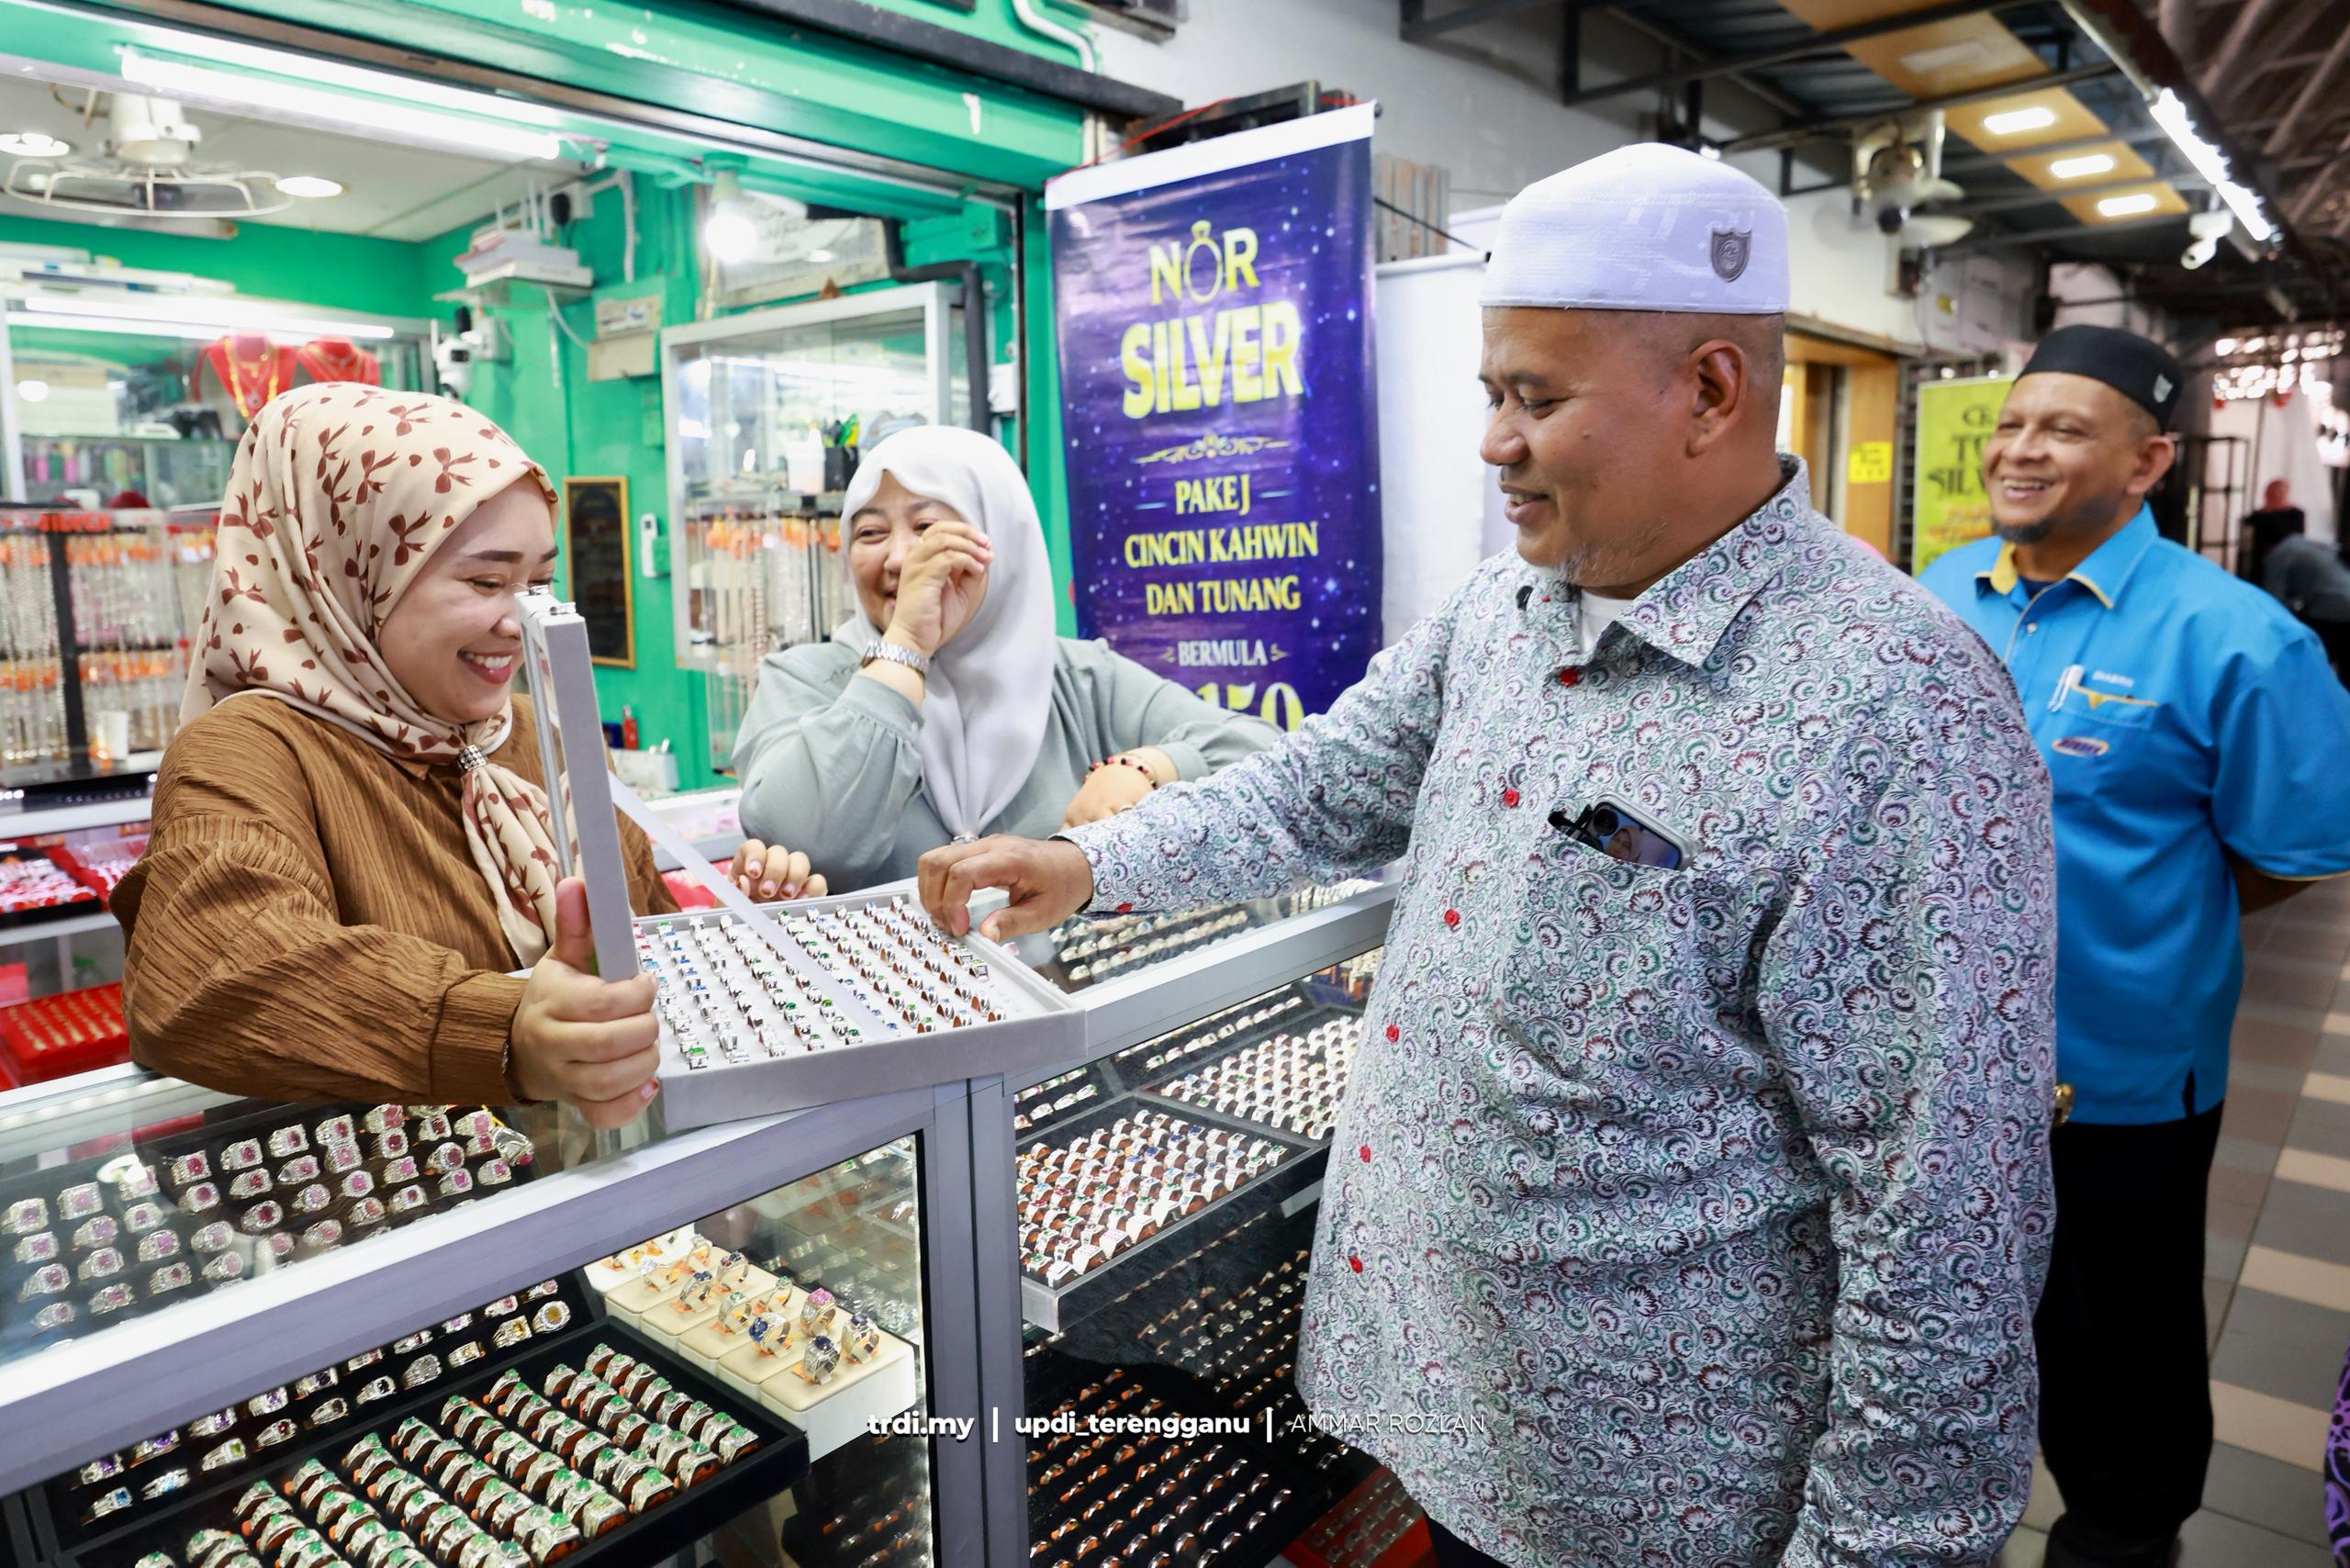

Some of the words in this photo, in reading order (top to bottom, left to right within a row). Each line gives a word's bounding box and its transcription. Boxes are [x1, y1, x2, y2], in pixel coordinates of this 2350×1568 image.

[1149, 227, 1261, 306] NOR
[1121, 300, 1304, 420] SILVER
[1175, 474, 1251, 516] PAKEJ
[1125, 529, 1205, 568] CINCIN
[1208, 521, 1319, 563] KAHWIN
[1145, 581, 1195, 615] DAN
[1196, 575, 1302, 613] TUNANG
[1177, 639, 1269, 666] BERMULA
